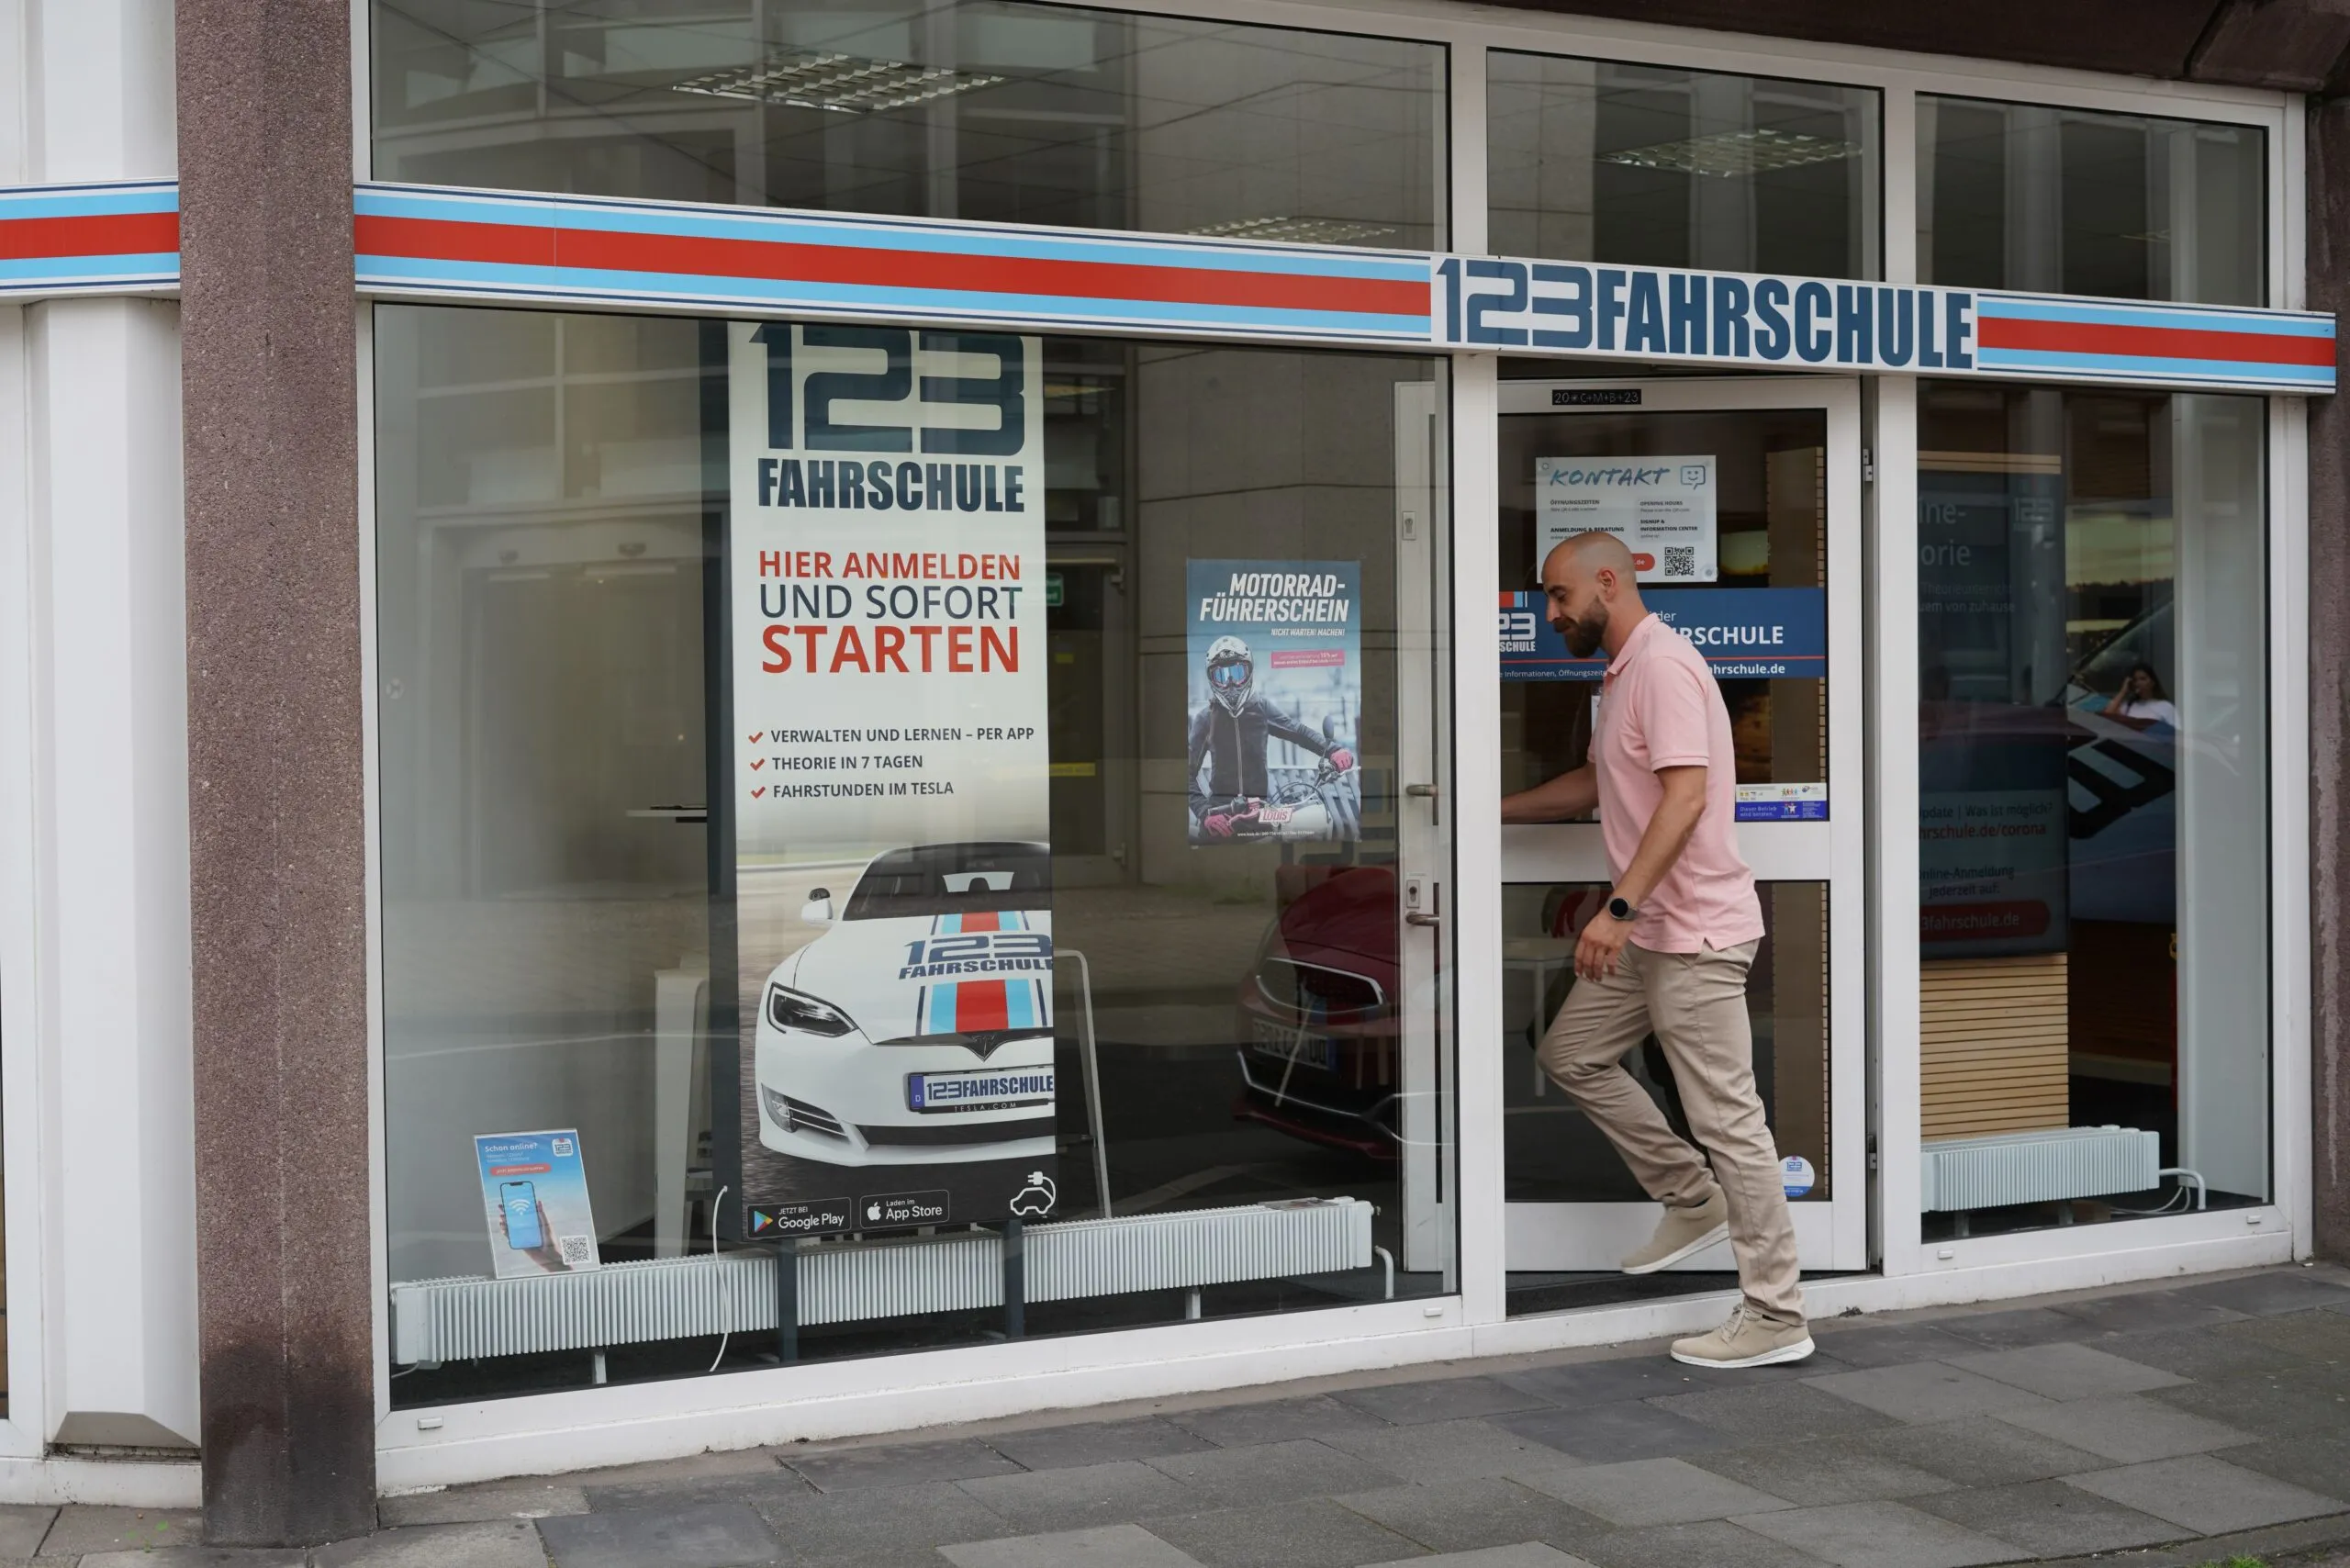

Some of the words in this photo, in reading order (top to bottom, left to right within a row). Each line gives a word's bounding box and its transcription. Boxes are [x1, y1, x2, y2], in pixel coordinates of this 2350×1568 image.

[749, 322, 1024, 456] 123
[758, 458, 1024, 512] FAHRSCHULE
[1550, 467, 1670, 487] KONTAKT
[1918, 496, 1967, 524] ine-
[1920, 539, 1971, 566] orie
[759, 551, 834, 578] HIER
[843, 553, 1020, 580] ANMELDEN
[1229, 573, 1345, 598] MOTORRAD-
[760, 584, 852, 619] UND
[867, 585, 1023, 620] SOFORT
[1200, 592, 1348, 622] FÜHRERSCHEIN
[1919, 602, 1942, 612] uem
[1271, 628, 1289, 636] NICHT
[1317, 628, 1345, 636] MACHEN!
[1673, 626, 1784, 645] RSCHULE
[762, 624, 1019, 673] STARTEN
[1500, 641, 1536, 653] SCHULE
[1505, 670, 1557, 678] Informationen,
[771, 729, 862, 743] VERWALTEN
[867, 729, 900, 742] UND
[904, 728, 961, 741] LERNEN
[977, 728, 1003, 740] PER
[1007, 727, 1035, 740] APP
[772, 756, 836, 770] THEORIE
[841, 756, 856, 769] IN
[862, 756, 869, 769] 7
[874, 756, 923, 769] TAGEN
[773, 783, 884, 798] FAHRSTUNDEN
[889, 783, 907, 796] IM
[912, 782, 954, 795] TESLA
[1919, 823, 2046, 840] hrschule.de/corona
[1919, 912, 2020, 931] 3fahrschule.de
[904, 935, 1053, 966] 123
[955, 1103, 1016, 1112] TESLA.COM
[510, 1142, 538, 1150] online?
[778, 1215, 820, 1230] Google
[822, 1213, 844, 1226] Play
[886, 1207, 910, 1221] App
[912, 1205, 942, 1217] Store
